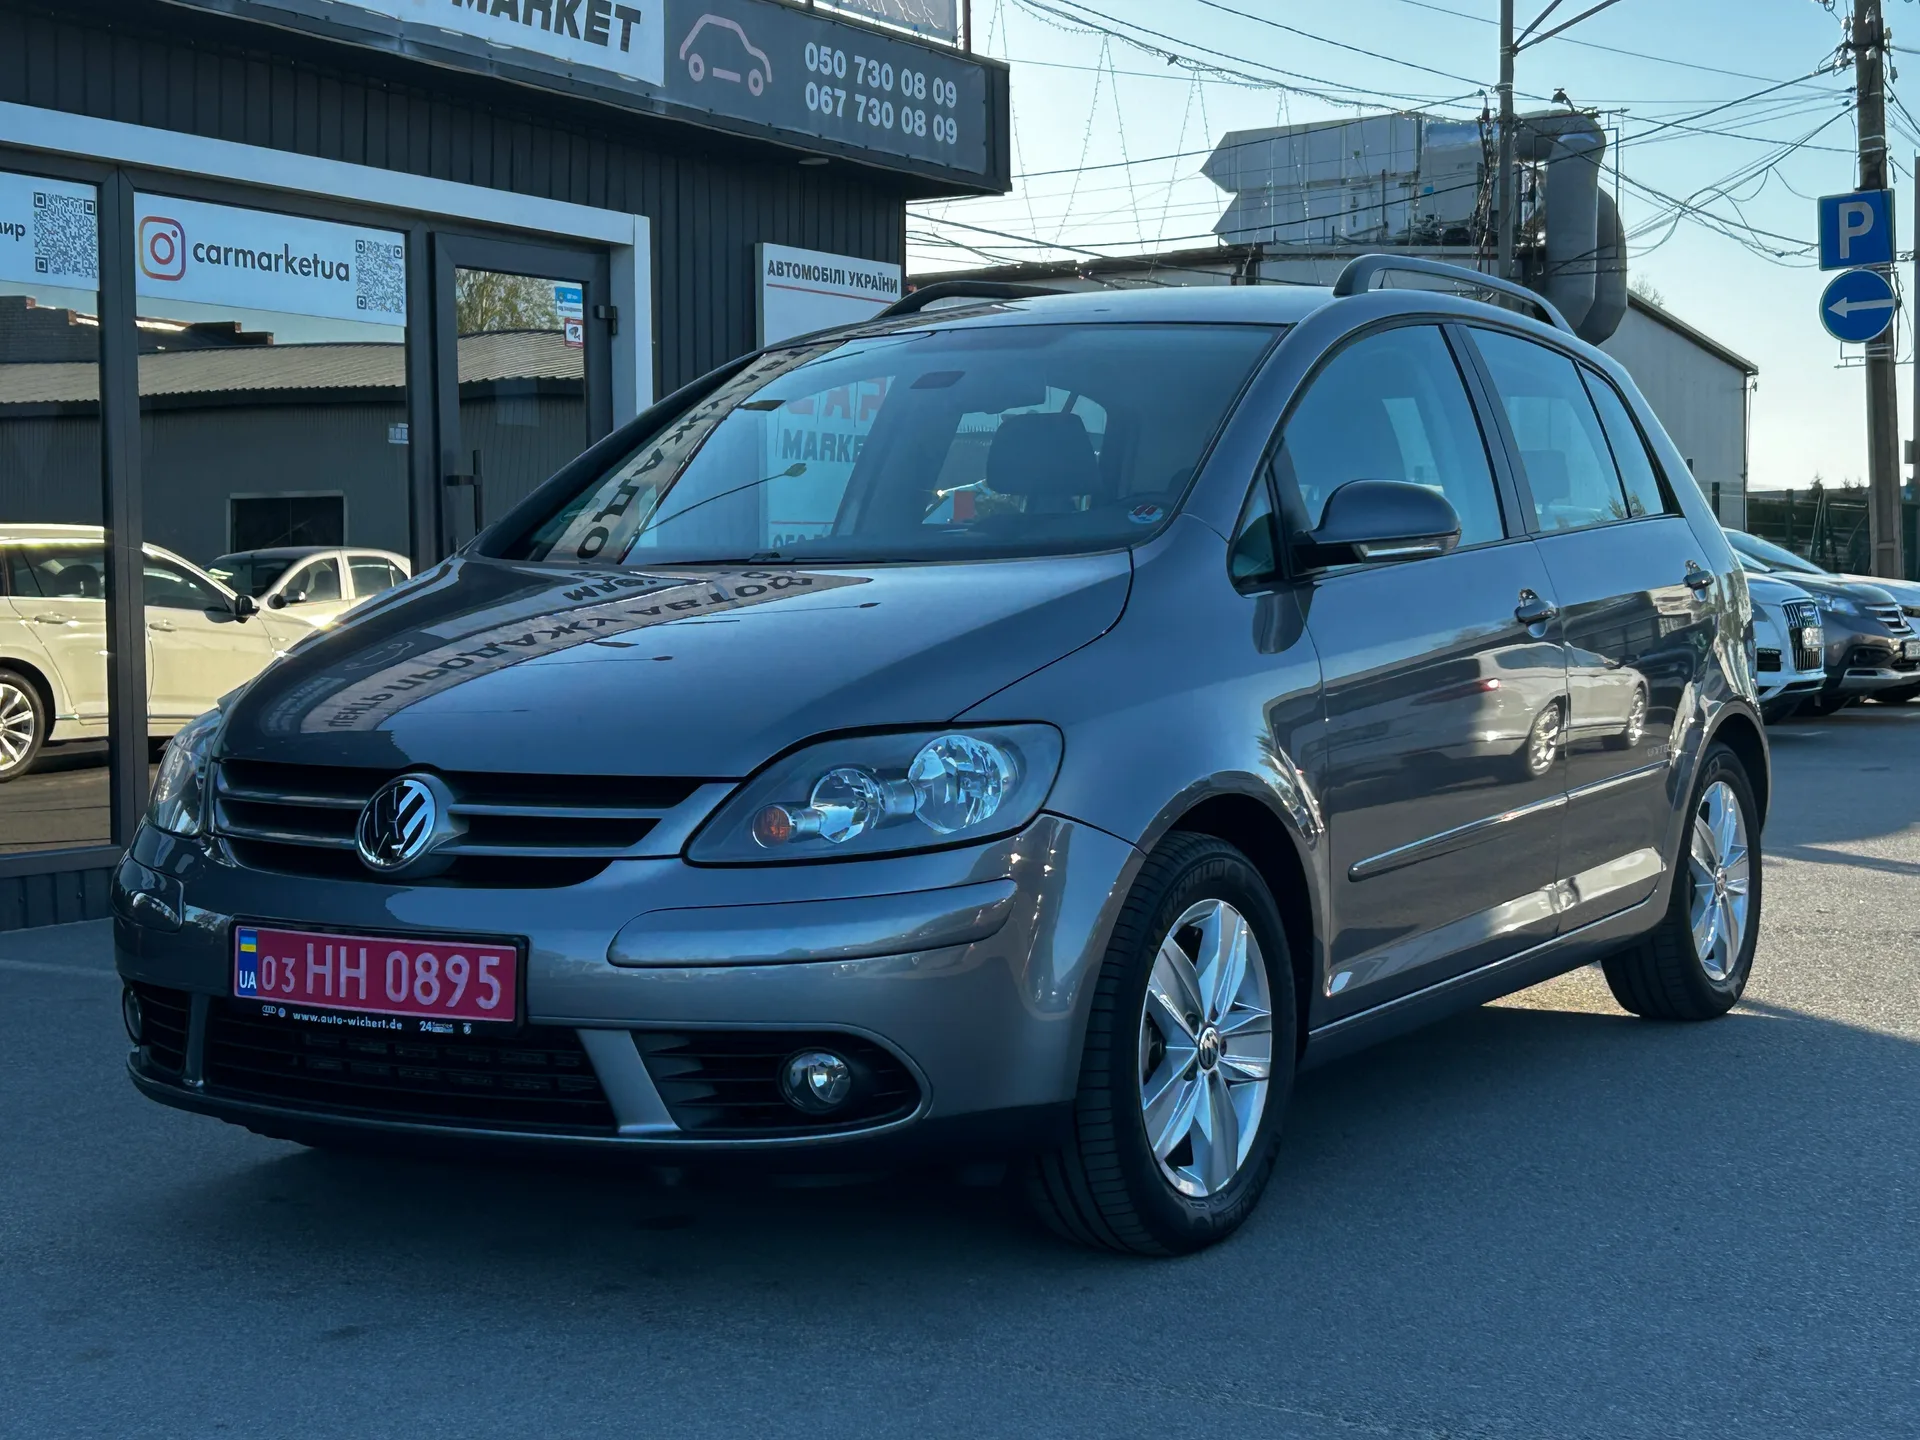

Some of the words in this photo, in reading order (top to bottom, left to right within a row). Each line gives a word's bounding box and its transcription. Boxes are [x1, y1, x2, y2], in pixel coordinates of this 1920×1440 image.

[452, 0, 642, 53] RKET
[804, 41, 847, 79] 050
[854, 55, 894, 91] 730
[900, 68, 927, 100] 08
[932, 77, 957, 108] 09
[805, 81, 847, 118] 067
[854, 94, 894, 129] 730
[901, 106, 927, 137] 08
[932, 114, 958, 145] 09
[1838, 201, 1875, 260] P
[192, 243, 350, 282] carmarketua
[767, 259, 846, 286] АВТОМОБІЛІ
[848, 271, 898, 294] УКРАЇНИ
[239, 970, 257, 989] UA
[261, 955, 296, 993] 03
[306, 943, 367, 1000] HH
[385, 950, 501, 1010] 0895
[293, 1011, 403, 1031] www.auto-wichert.de
